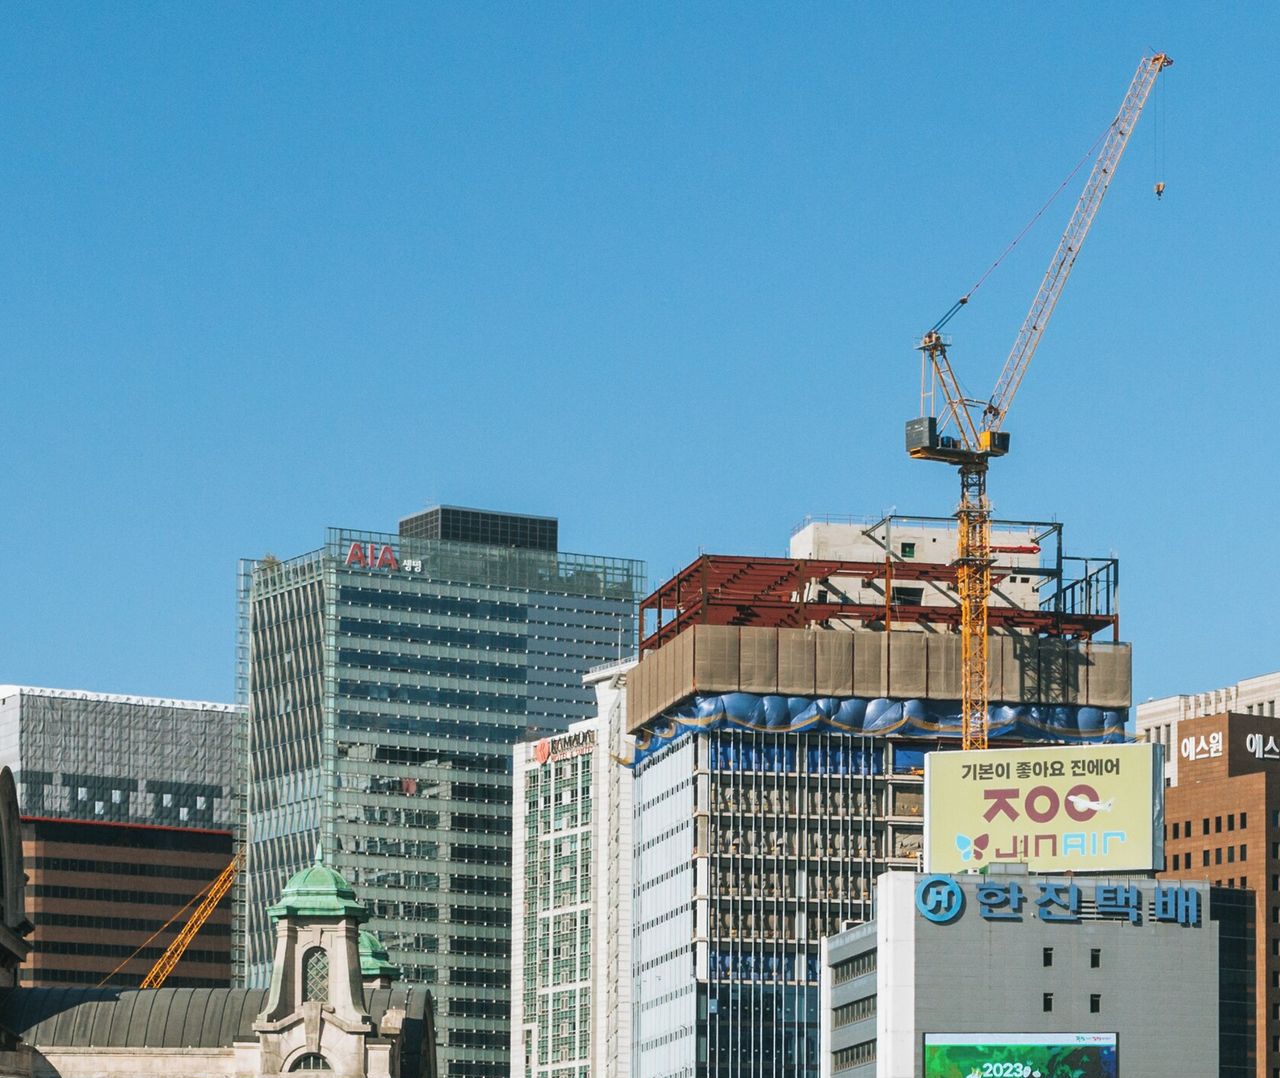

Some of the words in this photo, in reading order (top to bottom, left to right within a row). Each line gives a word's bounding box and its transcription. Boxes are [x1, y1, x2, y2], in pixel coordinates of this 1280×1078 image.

[344, 543, 399, 569] AIA
[402, 560, 422, 572] 생명
[1181, 732, 1222, 760] 에스원
[961, 762, 1011, 780] 기본이
[1016, 760, 1066, 779] 좋아요
[1070, 758, 1120, 777] 진에어
[976, 881, 1199, 924] 한진택배
[982, 1063, 1024, 1078] 2023
